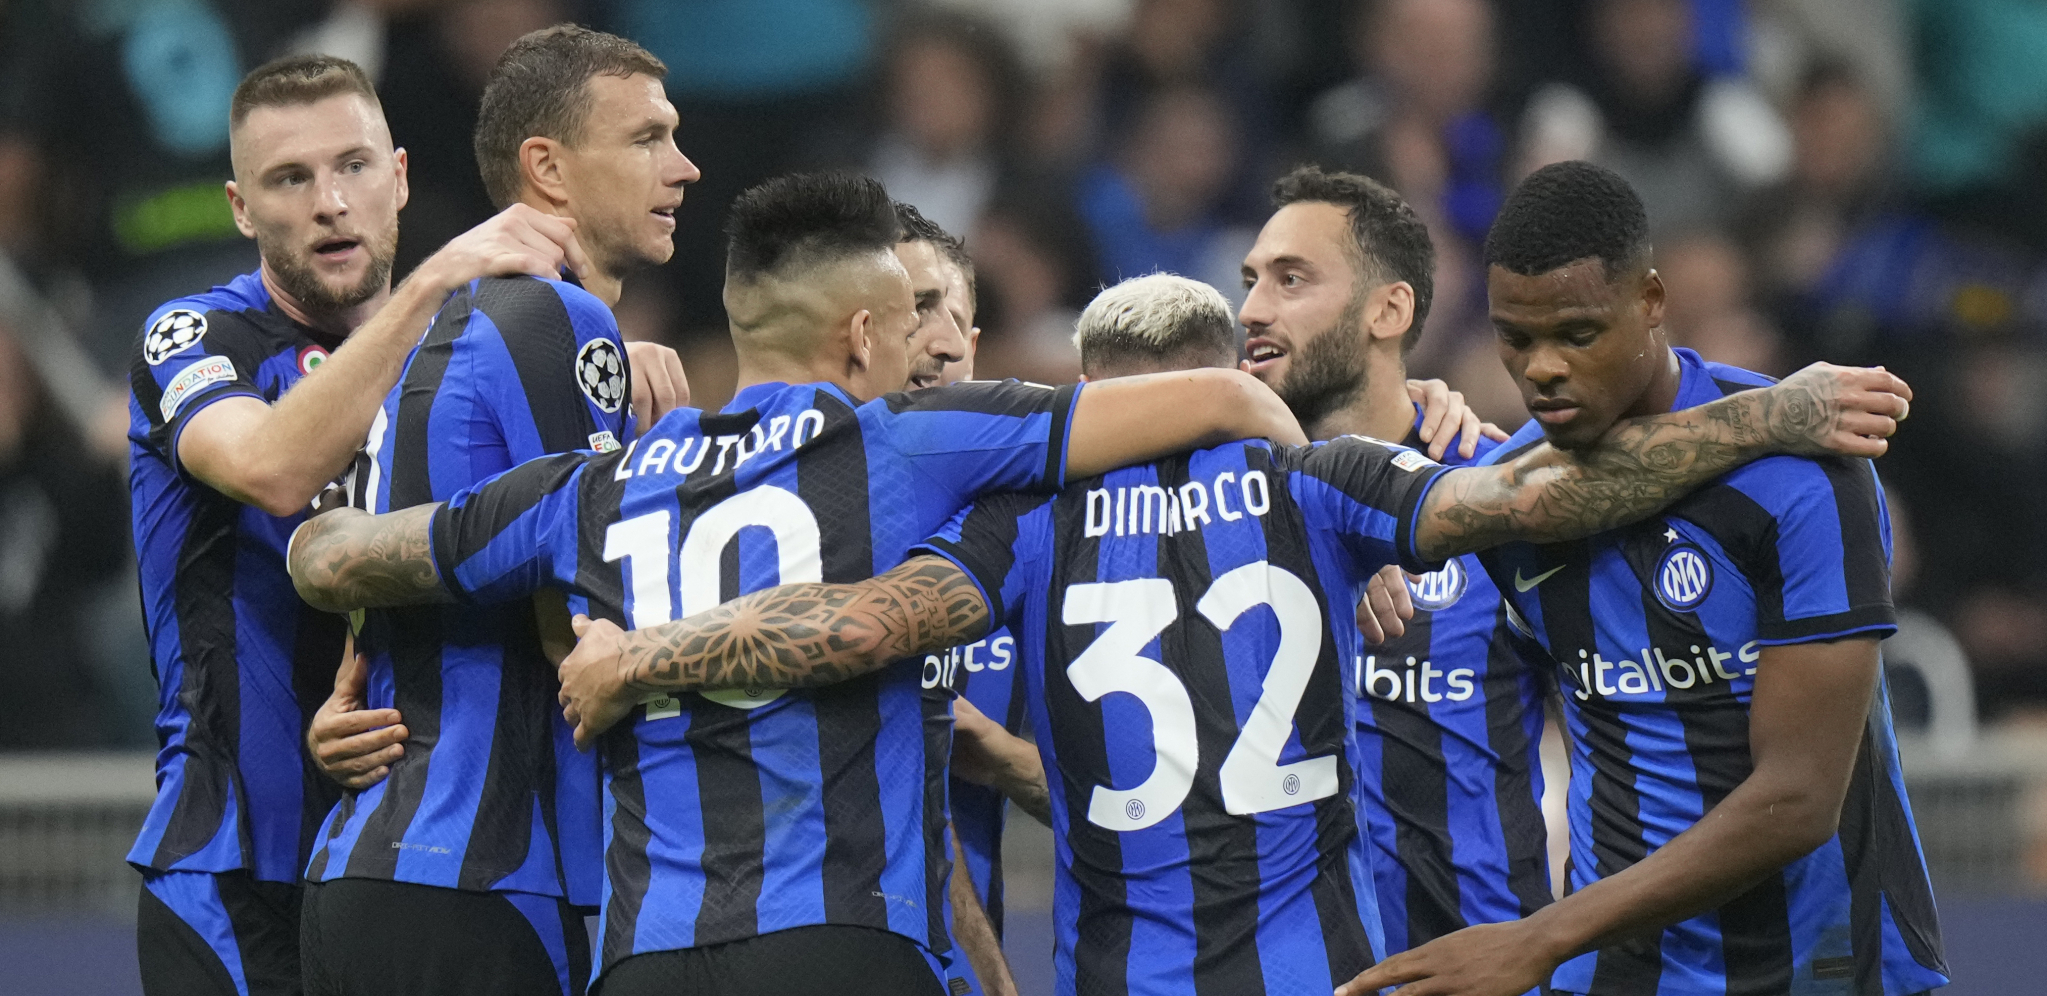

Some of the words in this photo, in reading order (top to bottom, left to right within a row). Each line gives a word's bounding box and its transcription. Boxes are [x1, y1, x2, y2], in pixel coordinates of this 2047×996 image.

[162, 363, 232, 415] FOUNDATION
[1084, 470, 1270, 538] DIMARCO
[602, 484, 823, 722] 10
[1062, 559, 1339, 832] 32
